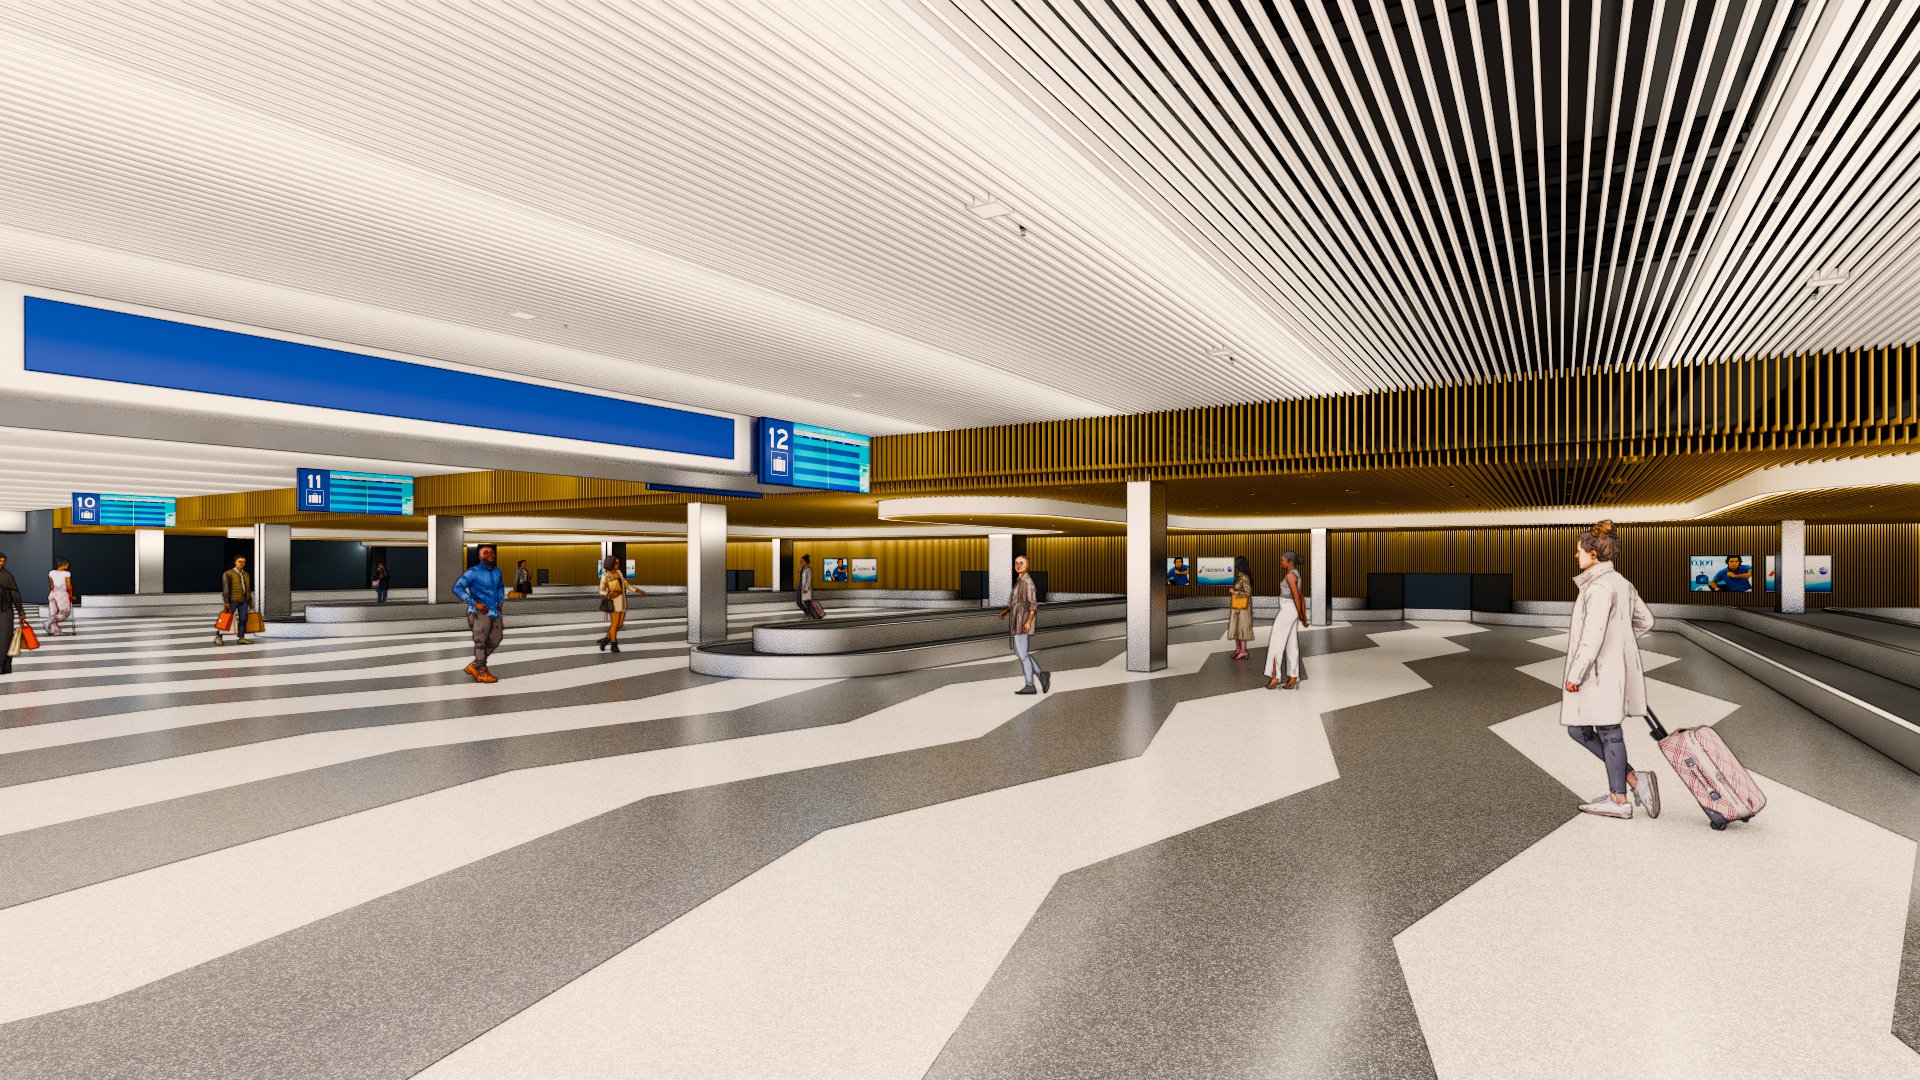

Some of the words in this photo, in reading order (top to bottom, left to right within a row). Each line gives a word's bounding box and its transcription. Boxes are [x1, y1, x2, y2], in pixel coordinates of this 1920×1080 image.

[769, 427, 789, 450] 12
[307, 474, 321, 489] 11
[77, 496, 96, 508] 10
